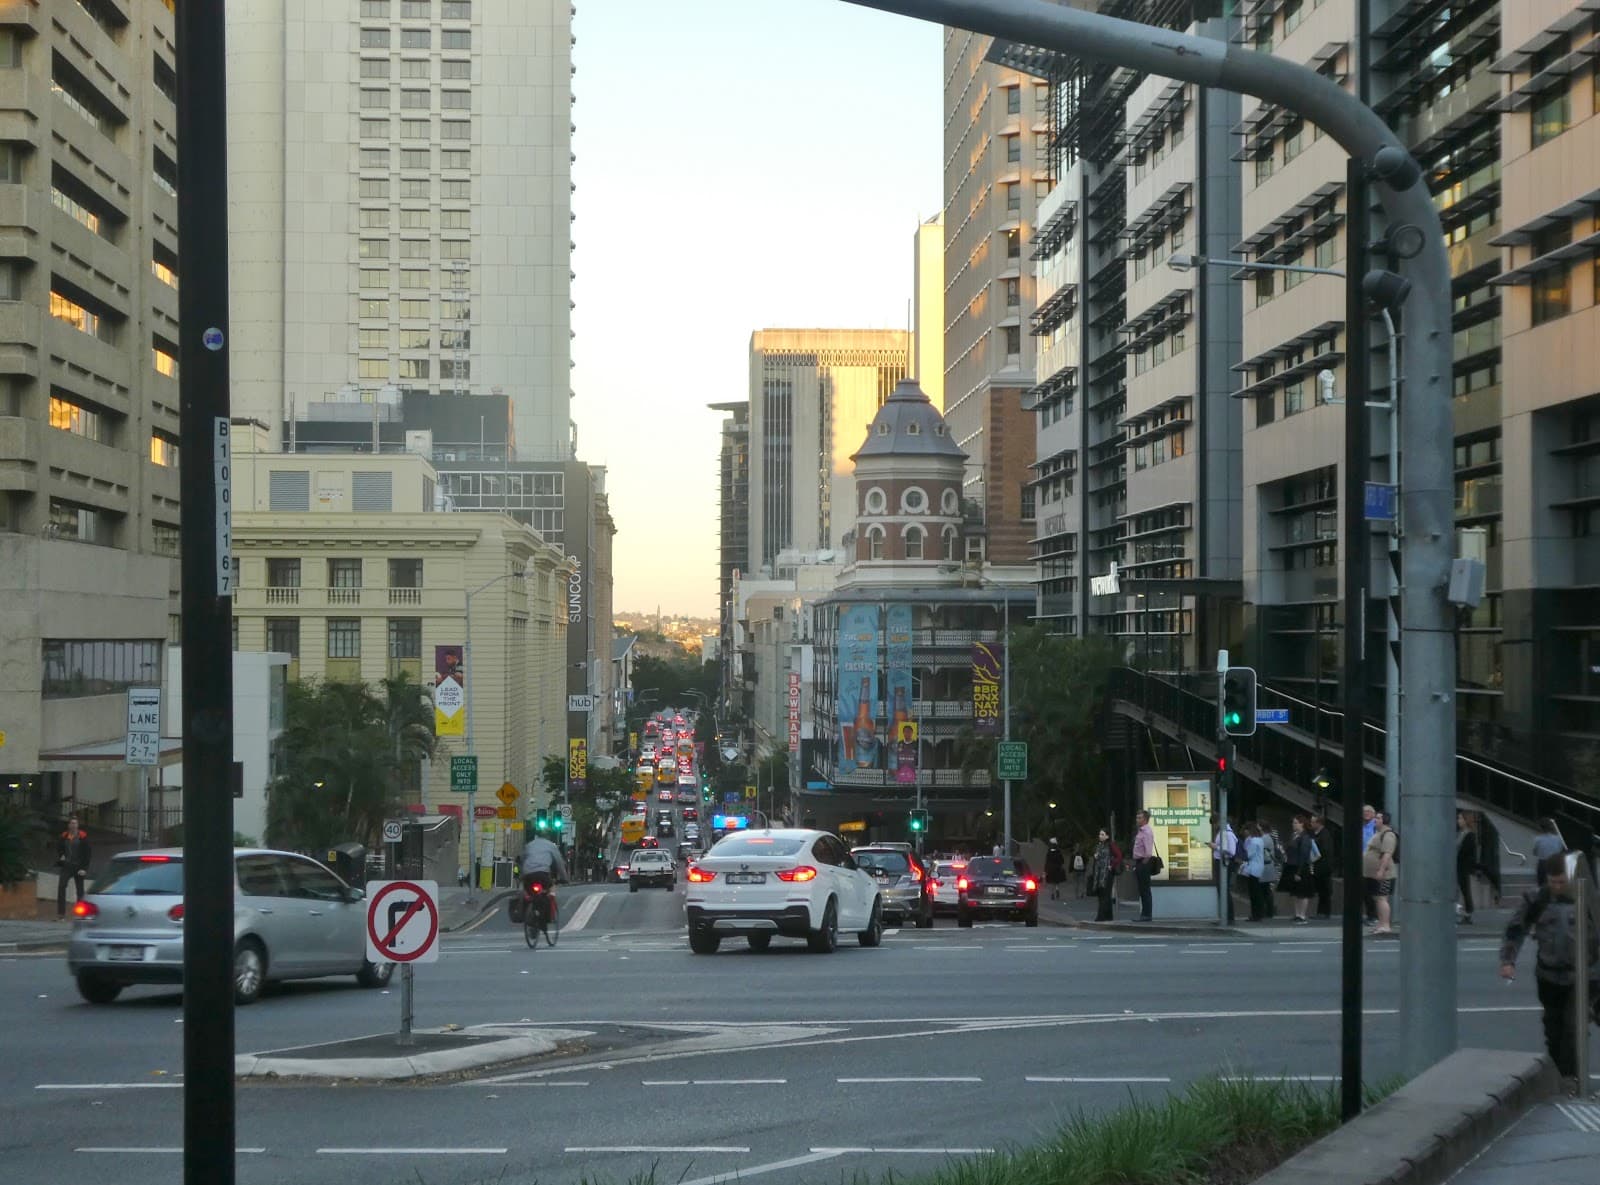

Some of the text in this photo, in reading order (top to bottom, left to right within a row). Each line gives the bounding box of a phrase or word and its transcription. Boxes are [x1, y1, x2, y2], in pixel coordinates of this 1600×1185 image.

[218, 421, 230, 592] B1001167
[571, 696, 591, 707] hub
[790, 675, 799, 744] BOWMAN
[130, 713, 158, 724] LANE
[1151, 808, 1168, 816] Tailor
[1174, 808, 1204, 816] wardrobe
[1156, 817, 1163, 825] to
[1179, 818, 1198, 826] space
[386, 825, 399, 835] 40
